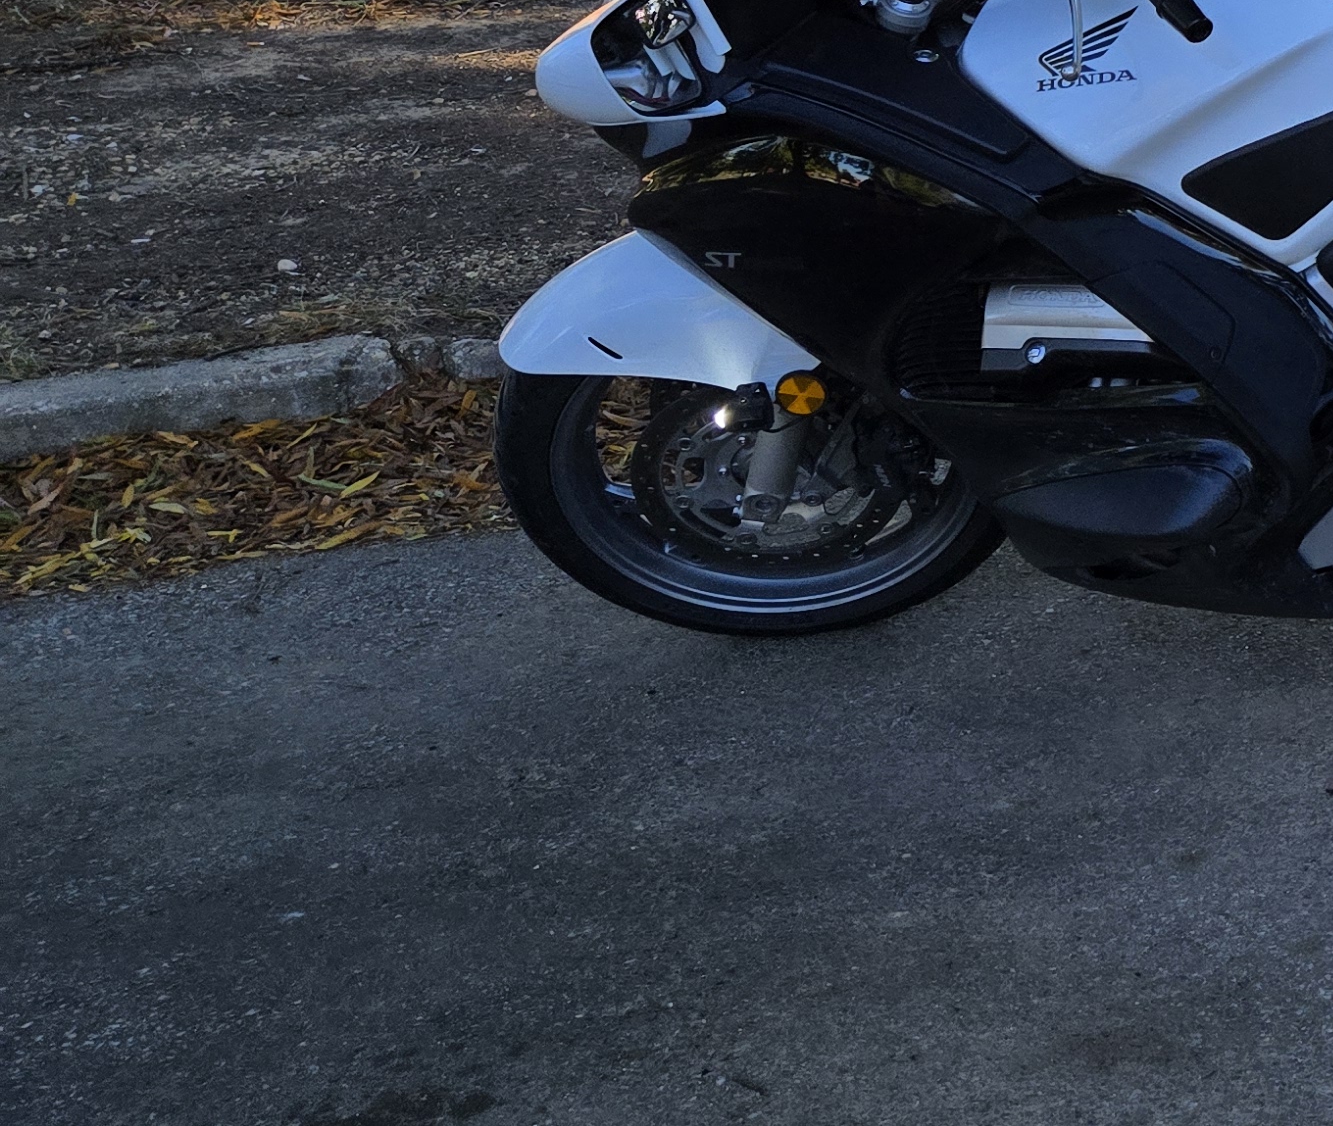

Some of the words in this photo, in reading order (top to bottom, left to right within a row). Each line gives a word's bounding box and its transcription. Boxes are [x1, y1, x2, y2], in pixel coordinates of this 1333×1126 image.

[1036, 69, 1138, 93] HONDA
[704, 251, 742, 269] ST
[1018, 288, 1101, 304] HONDA
